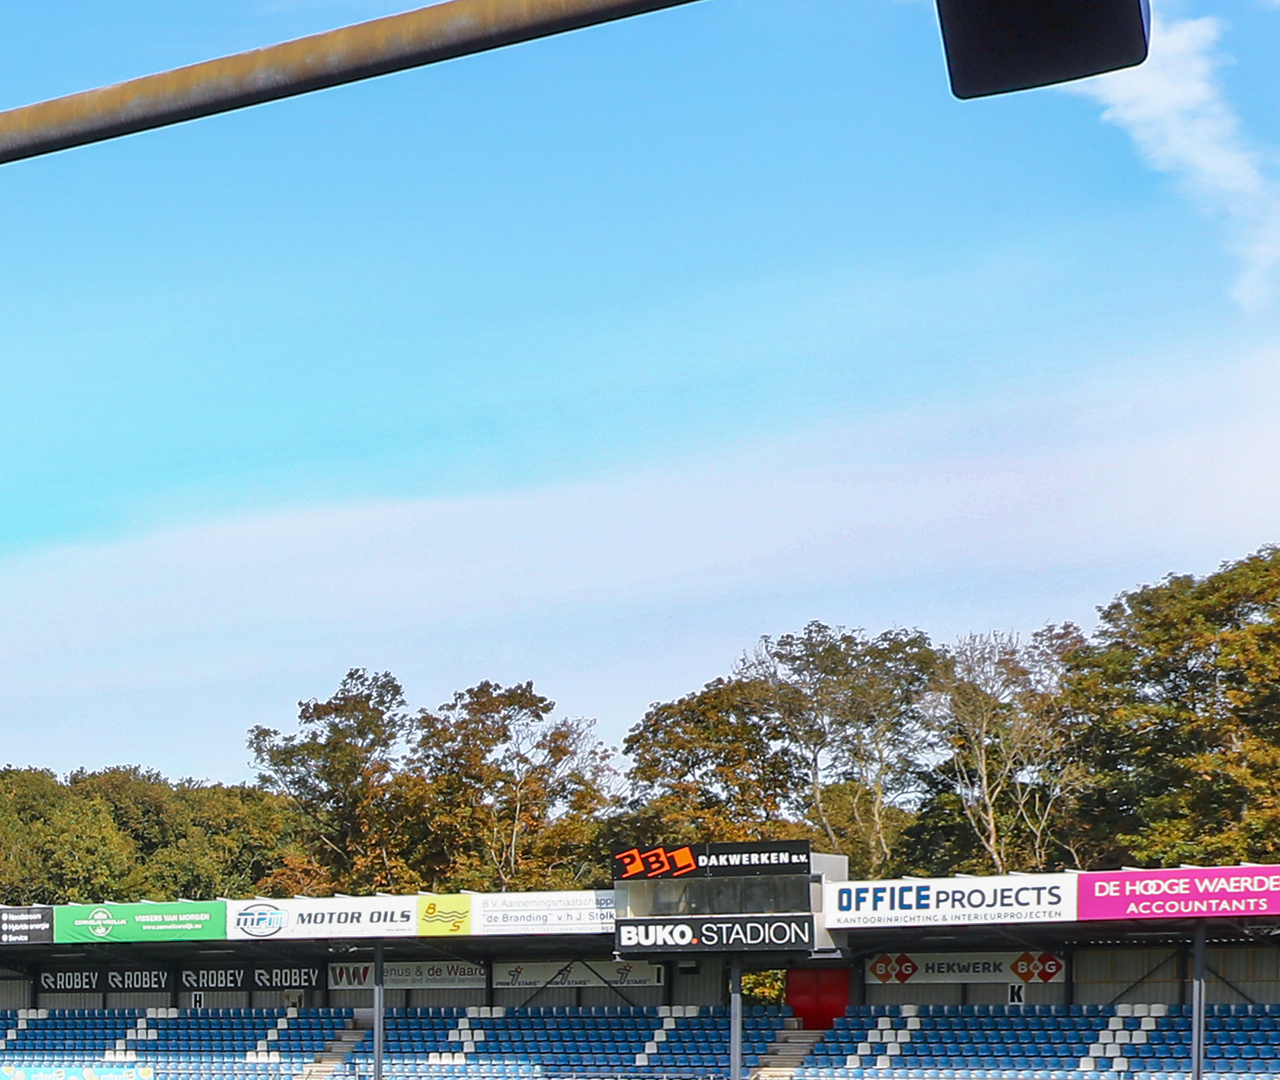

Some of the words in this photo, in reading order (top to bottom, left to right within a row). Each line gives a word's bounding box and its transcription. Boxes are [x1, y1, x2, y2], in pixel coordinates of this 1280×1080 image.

[698, 852, 790, 867] DAKWERKEN
[1095, 881, 1121, 898] DE
[1125, 878, 1190, 896] HOOGE
[1194, 875, 1280, 894] WAERDE
[501, 896, 615, 909] Aannemingsmaatschappi
[838, 886, 930, 911] OFFICE
[935, 886, 1062, 910] PROJECTS
[1127, 898, 1268, 915] ACCOUNTANTS
[164, 914, 179, 922] VAN
[297, 911, 363, 925] MOTOR
[369, 910, 412, 923] OILS
[588, 910, 616, 921] Stolk
[837, 914, 939, 926] KANTOORINRICHTING
[942, 914, 949, 922] &
[951, 910, 1062, 923] INTERIEURPROJECTEN
[620, 924, 700, 947] BUKO.
[700, 922, 810, 945] STADION
[383, 967, 411, 978] enus
[415, 966, 424, 977] &
[427, 965, 443, 977] de
[924, 961, 1004, 975] HEKWERK
[56, 971, 99, 989] ROBEY
[124, 971, 169, 989] ROBEY
[199, 970, 245, 988] ROBEY
[272, 969, 319, 986] ROBEY
[193, 993, 202, 1008] H
[1009, 984, 1024, 1003] K
